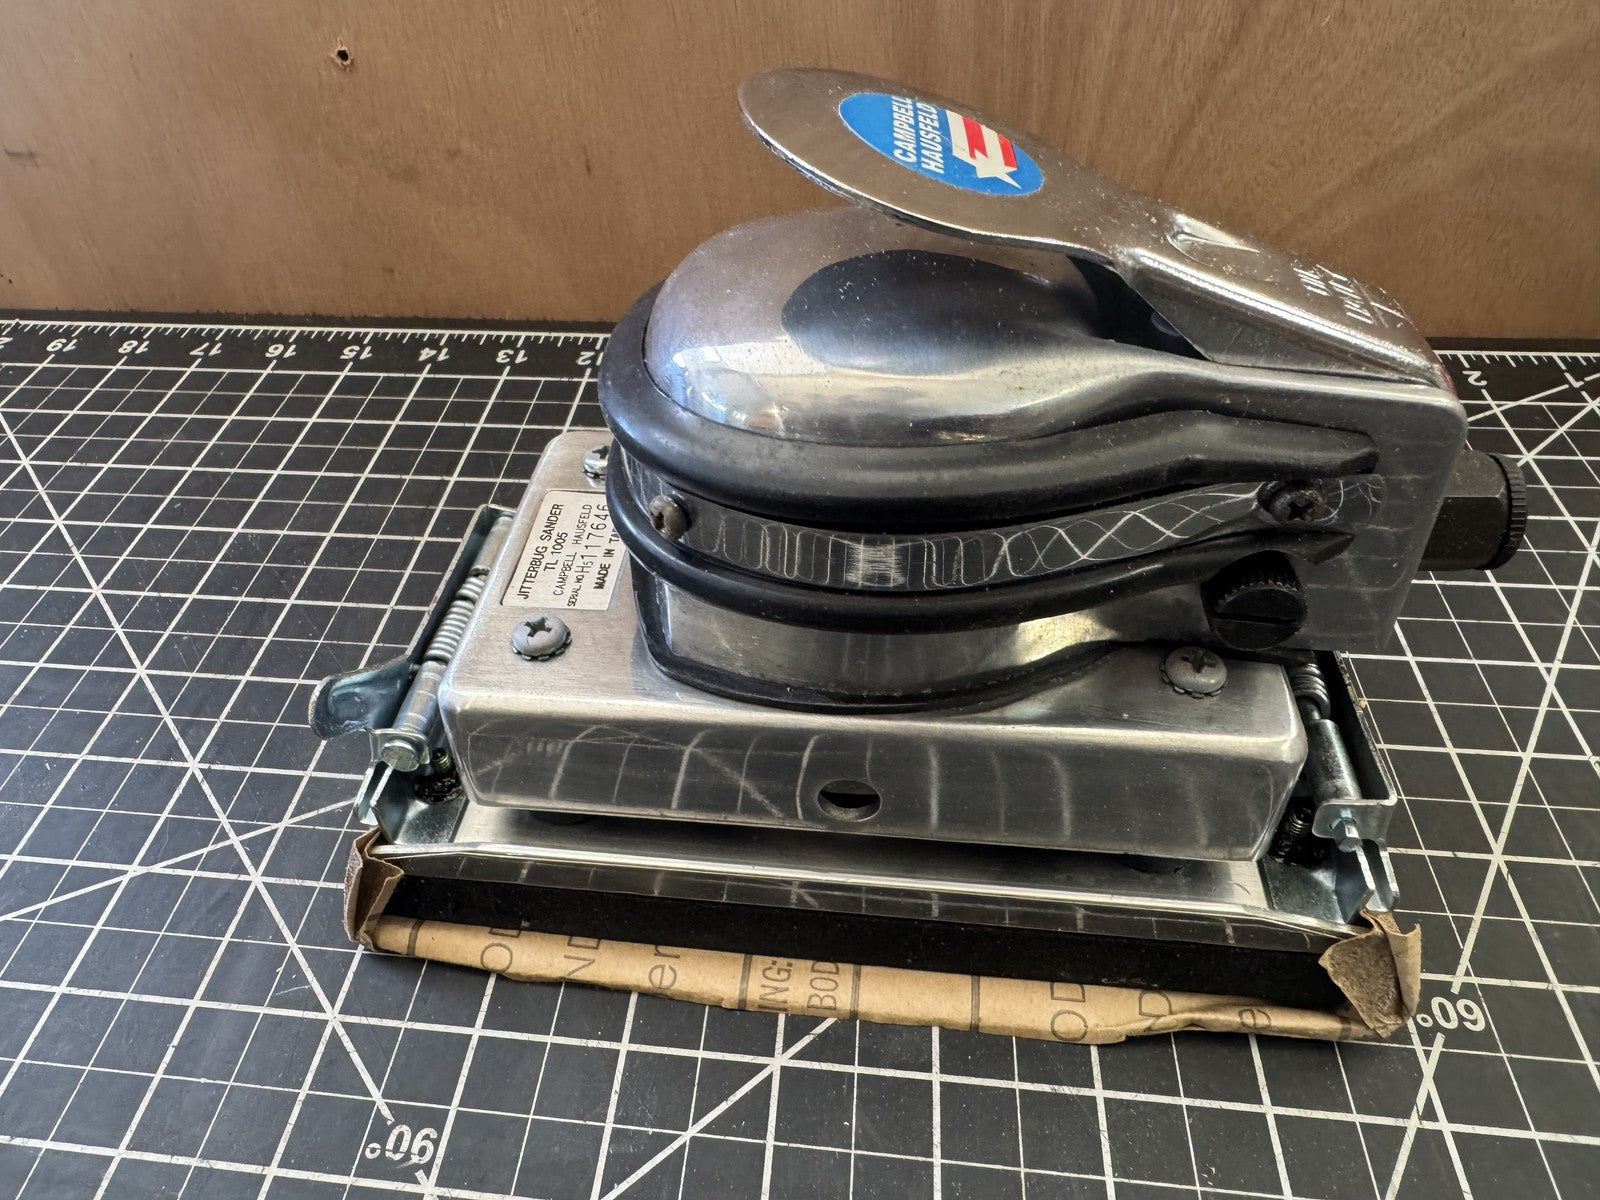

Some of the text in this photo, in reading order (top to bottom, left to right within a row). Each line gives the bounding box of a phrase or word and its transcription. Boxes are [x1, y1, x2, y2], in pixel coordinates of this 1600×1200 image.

[891, 96, 917, 163] CAMPBELL
[916, 102, 945, 174] HAUSFELD
[517, 503, 564, 600] JITTERBUG SANDER
[543, 532, 568, 572] TL 1005
[553, 504, 592, 596] CAMPBELL HAUSFELD
[593, 563, 611, 590] MADE
[603, 548, 615, 558] IN
